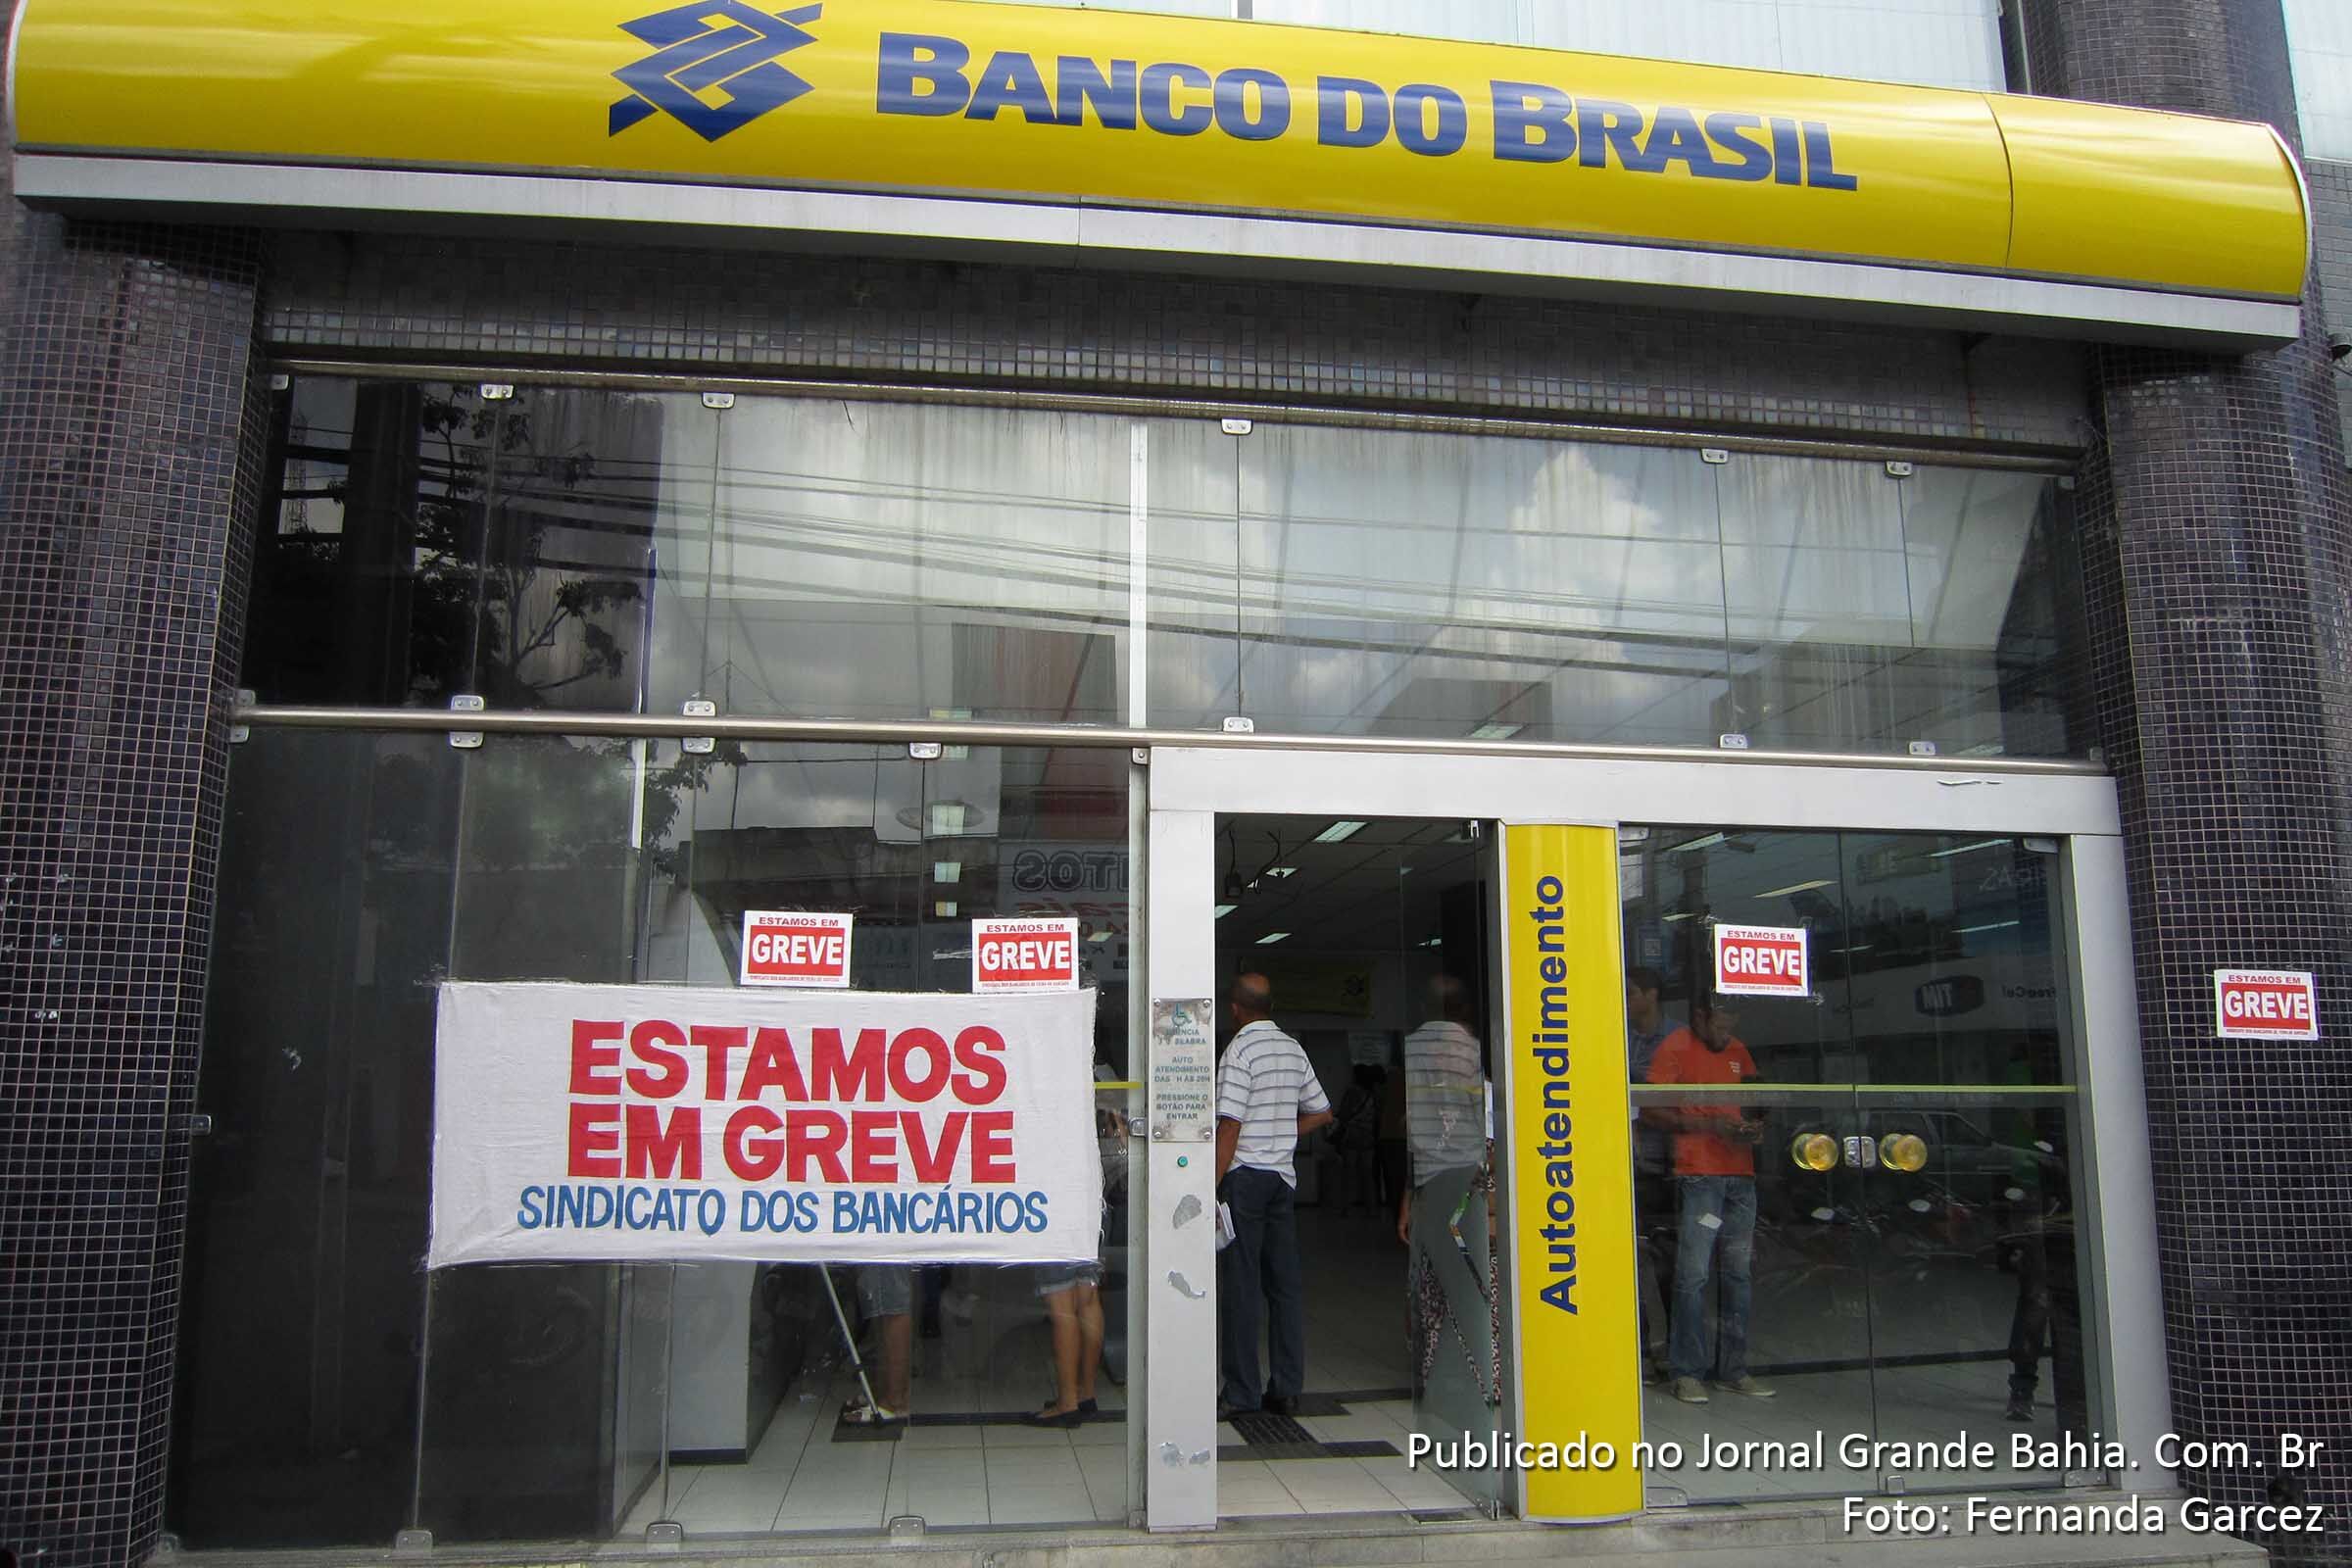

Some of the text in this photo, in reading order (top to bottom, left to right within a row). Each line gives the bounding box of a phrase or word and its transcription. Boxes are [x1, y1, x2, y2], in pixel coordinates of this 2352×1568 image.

[875, 31, 1858, 192] BANCO DO BRASIL
[759, 916, 817, 926] ESTAMOS
[1048, 923, 1064, 932] EM
[1727, 930, 1777, 941] ESTAMOS
[752, 933, 843, 965] GREVE
[981, 941, 1071, 971] GREVE
[1723, 945, 1801, 976] GREVE
[2228, 974, 2282, 984] ESTAMOS
[2225, 990, 2309, 1020] GREVE
[568, 1018, 1007, 1106] ESTAMOS
[1154, 1065, 1209, 1074] ATENDIMENTO
[1528, 875, 1578, 1315] Autoatendimento
[566, 1102, 1017, 1185] EM GREVE
[517, 1183, 1050, 1239] SINDICATO DOS BANCÁRIOS
